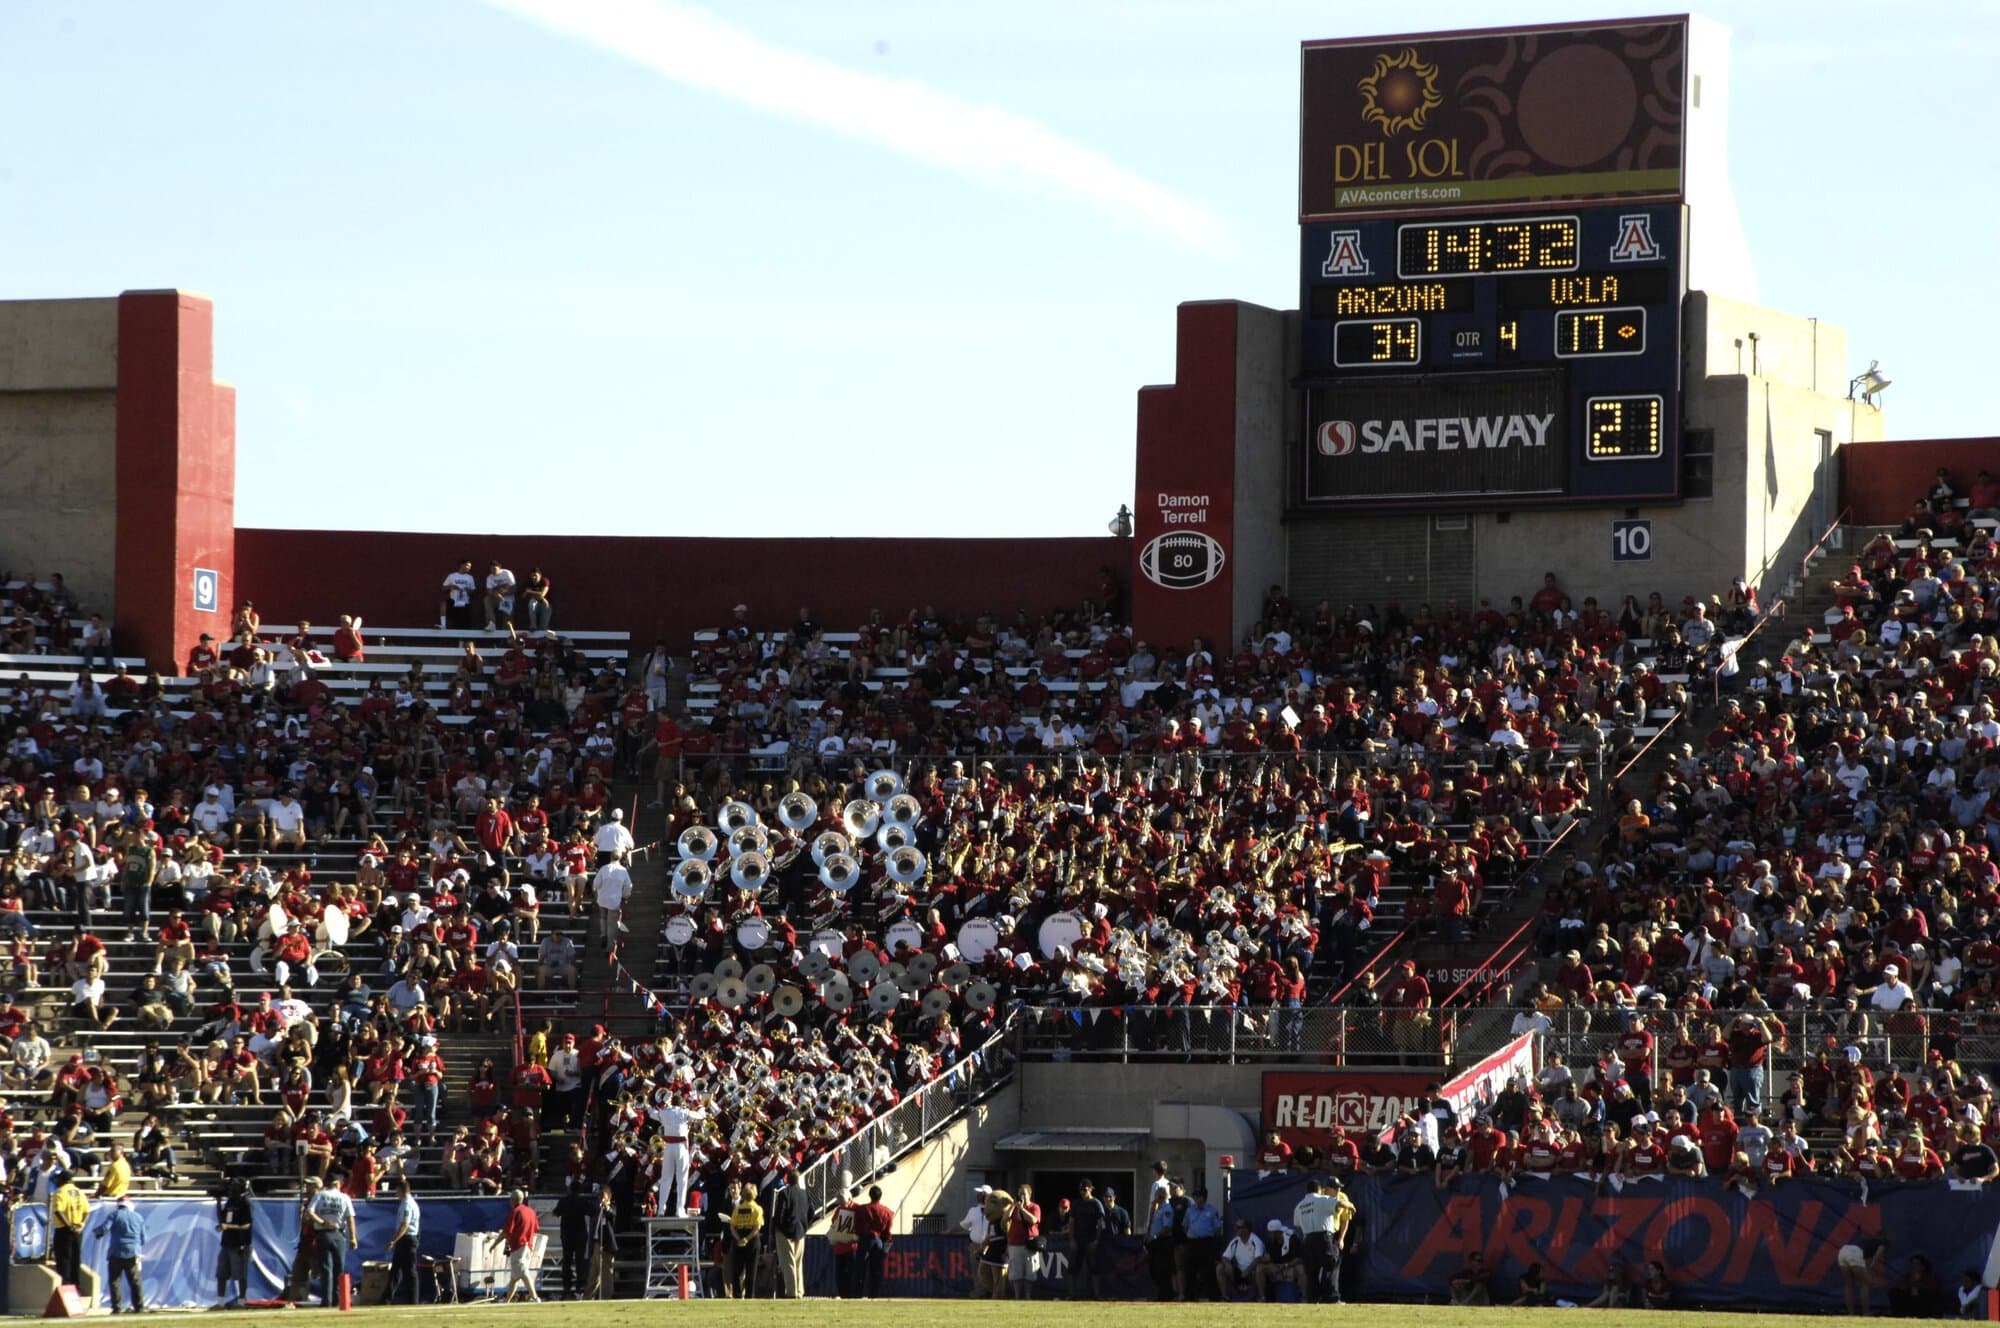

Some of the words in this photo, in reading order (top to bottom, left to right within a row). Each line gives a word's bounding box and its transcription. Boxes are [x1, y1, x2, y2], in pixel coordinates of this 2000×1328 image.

[1334, 143, 1390, 183] DEL
[1406, 138, 1464, 179] SOL
[1340, 185, 1462, 205] AVAconcerts.com
[1425, 222, 1575, 273] 14:32
[1336, 283, 1446, 315] ARIZONA
[1550, 276, 1619, 304] UCLA
[1371, 322, 1416, 360] 34
[1499, 321, 1517, 350] 4
[1572, 314, 1605, 352] 17
[1361, 413, 1555, 454] SAFEWAY
[1593, 400, 1659, 455] 21
[1157, 493, 1210, 508] Damon
[1161, 509, 1206, 524] Terrell
[1614, 526, 1651, 556] 10
[1173, 554, 1193, 568] 80
[198, 575, 213, 605] 9
[1436, 969, 1449, 983] 10
[1275, 1094, 1333, 1129] RED
[1367, 1096, 1420, 1130] ZON
[1401, 1195, 1885, 1288] ARIZONA
[882, 1251, 974, 1281] BEAR
